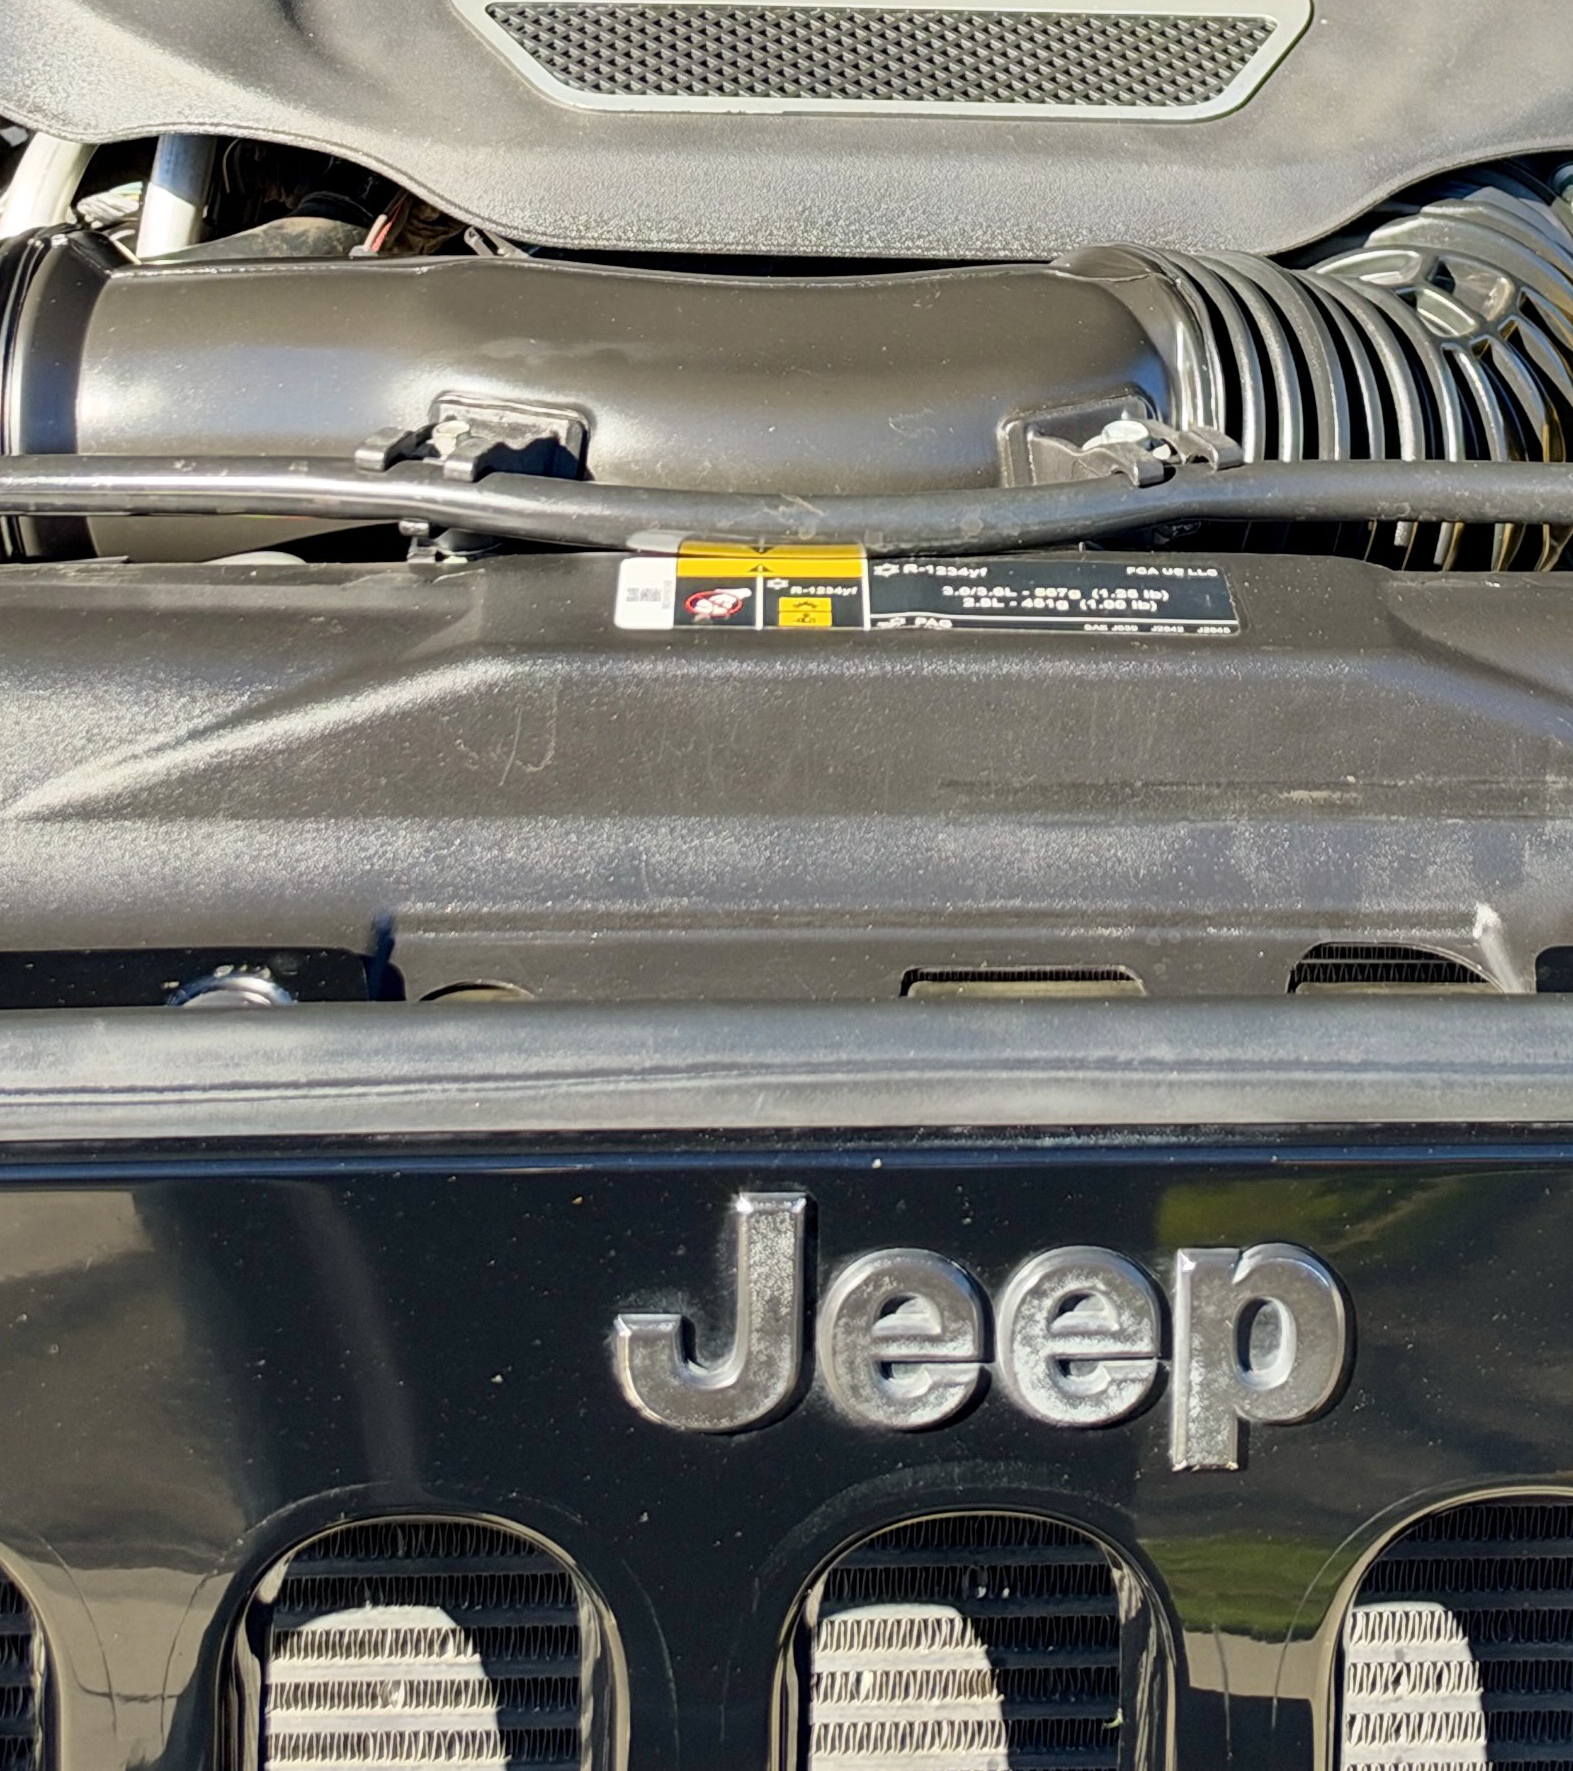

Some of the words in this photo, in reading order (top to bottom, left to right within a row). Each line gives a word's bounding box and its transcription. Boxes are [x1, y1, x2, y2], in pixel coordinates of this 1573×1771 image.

[1143, 588, 1170, 602] lb)
[1131, 599, 1158, 613] lb)
[613, 1191, 1349, 1472] Jeep
